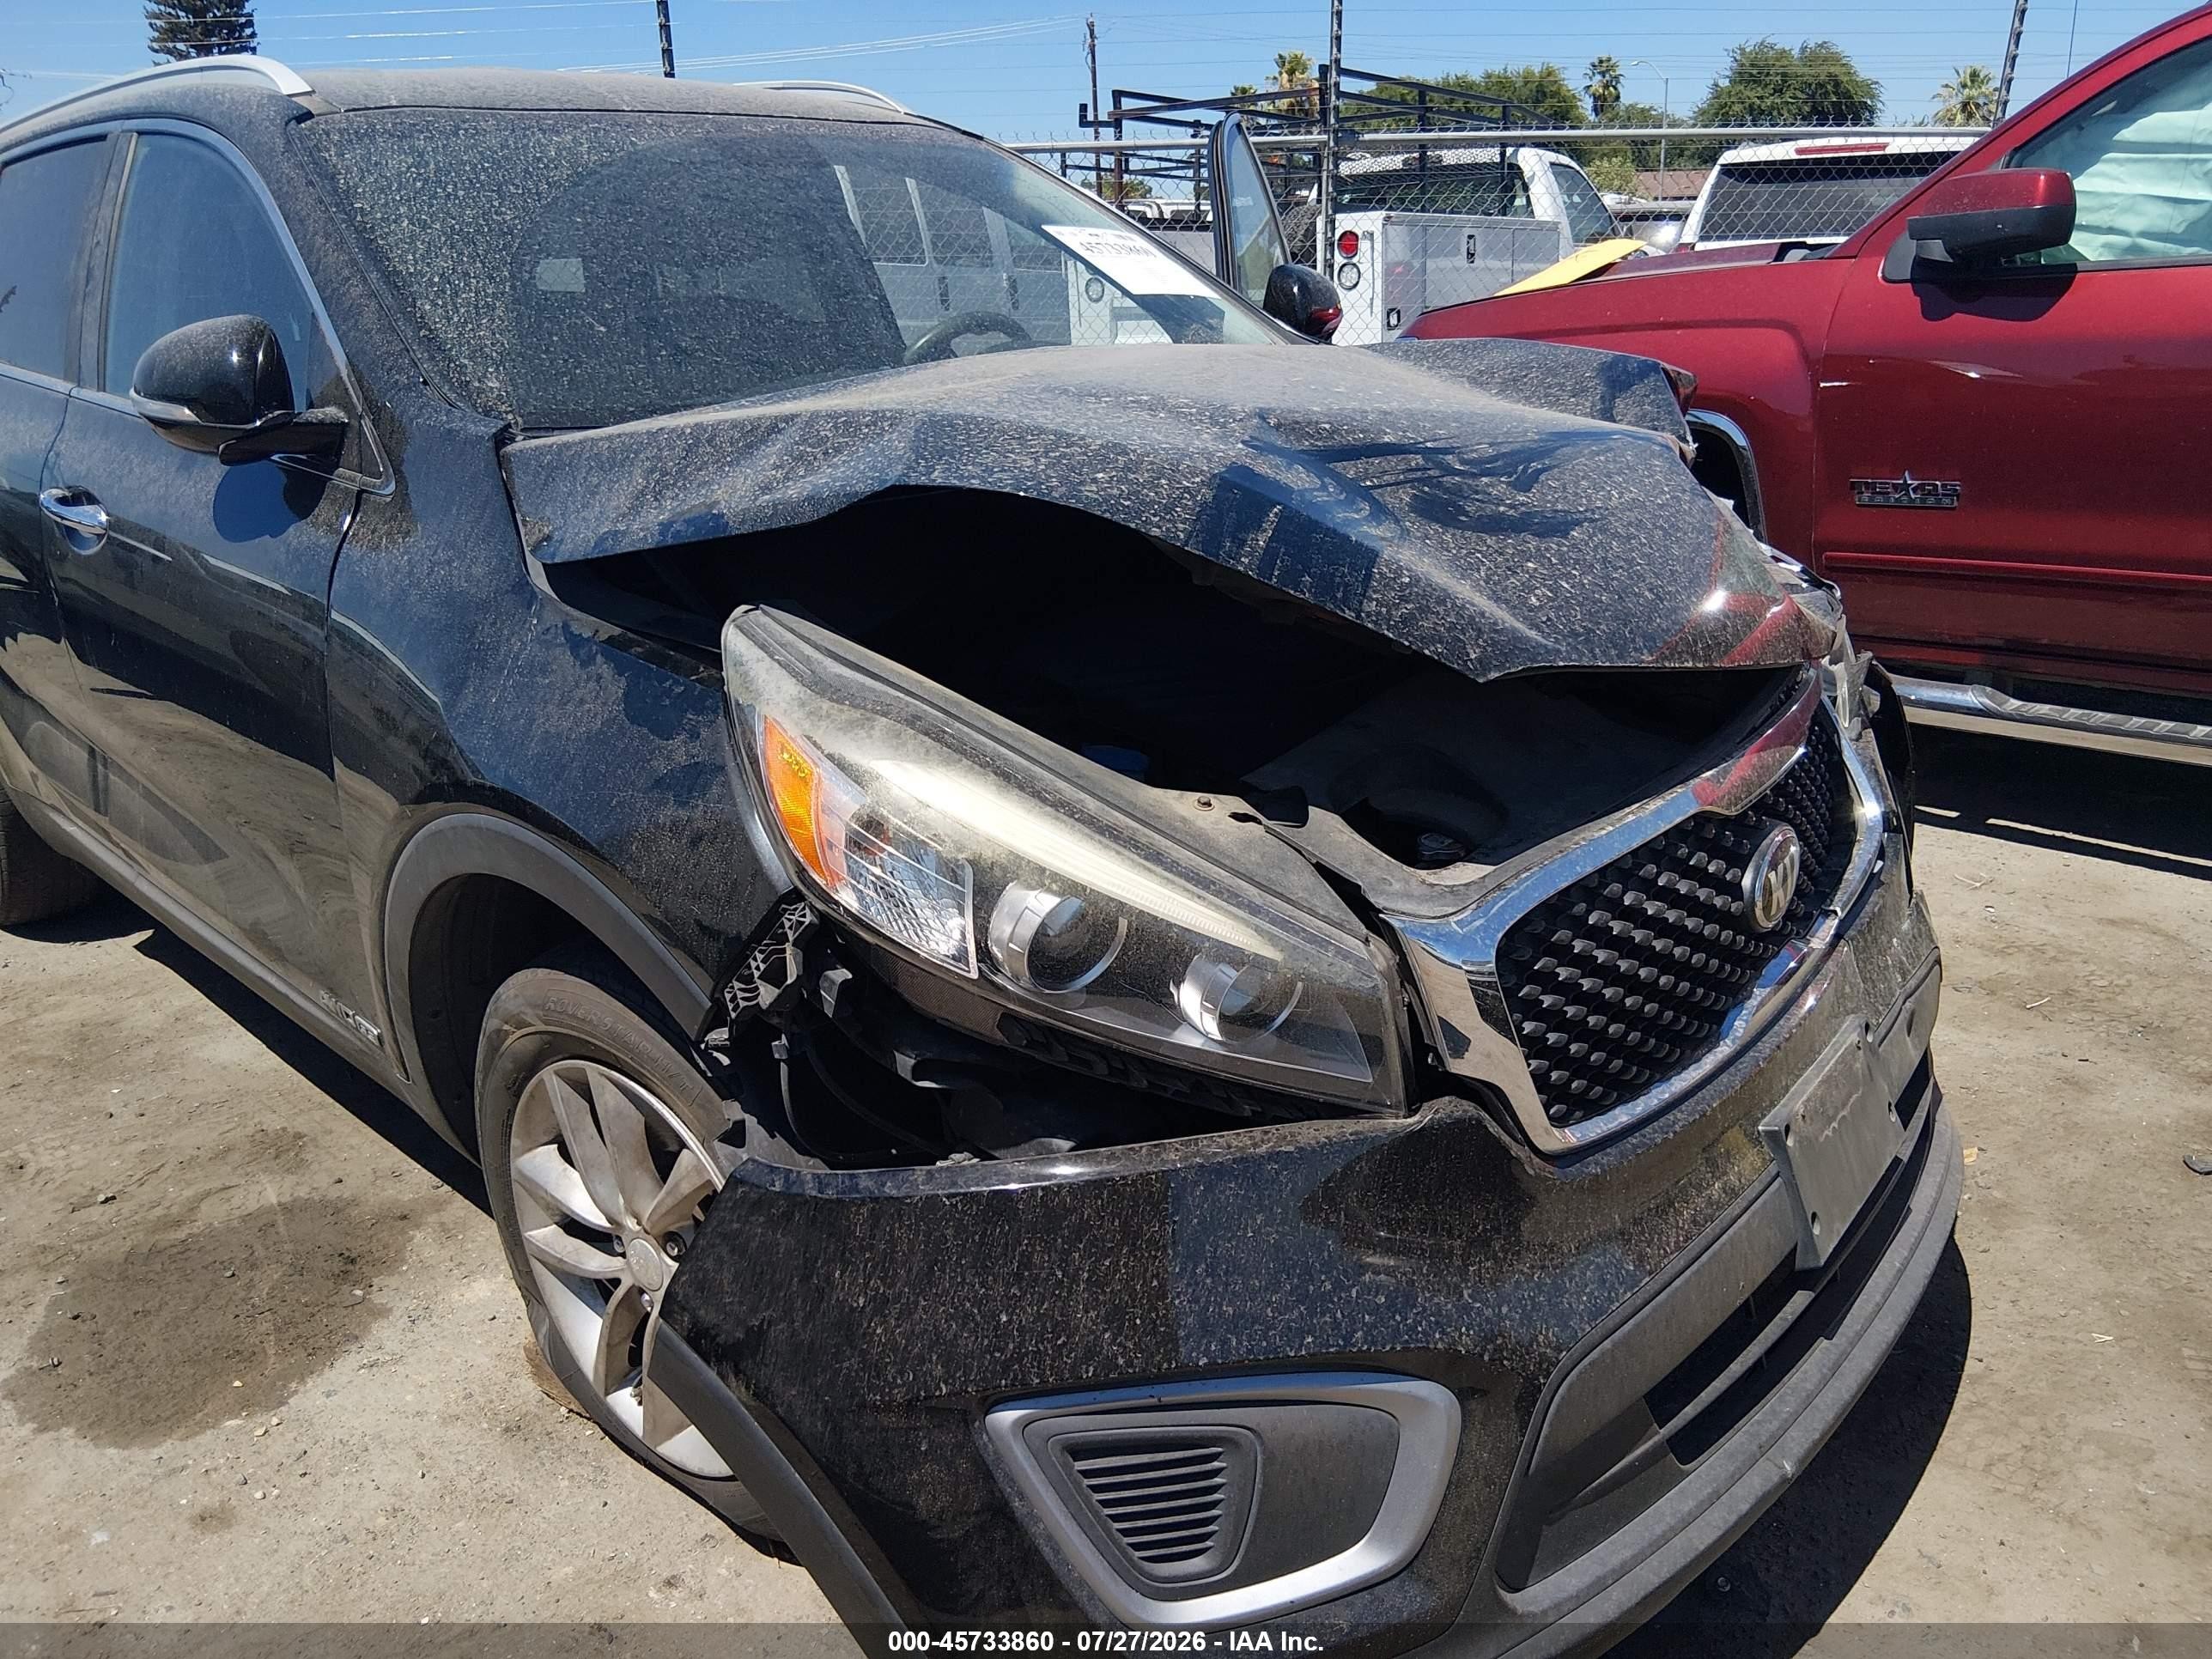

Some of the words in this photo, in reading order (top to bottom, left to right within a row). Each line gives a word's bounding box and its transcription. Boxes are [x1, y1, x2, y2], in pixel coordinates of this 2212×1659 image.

[1849, 475, 1961, 497] TEXAS
[544, 995, 653, 1059] ROVERSTAR
[654, 1054, 694, 1093] H/T
